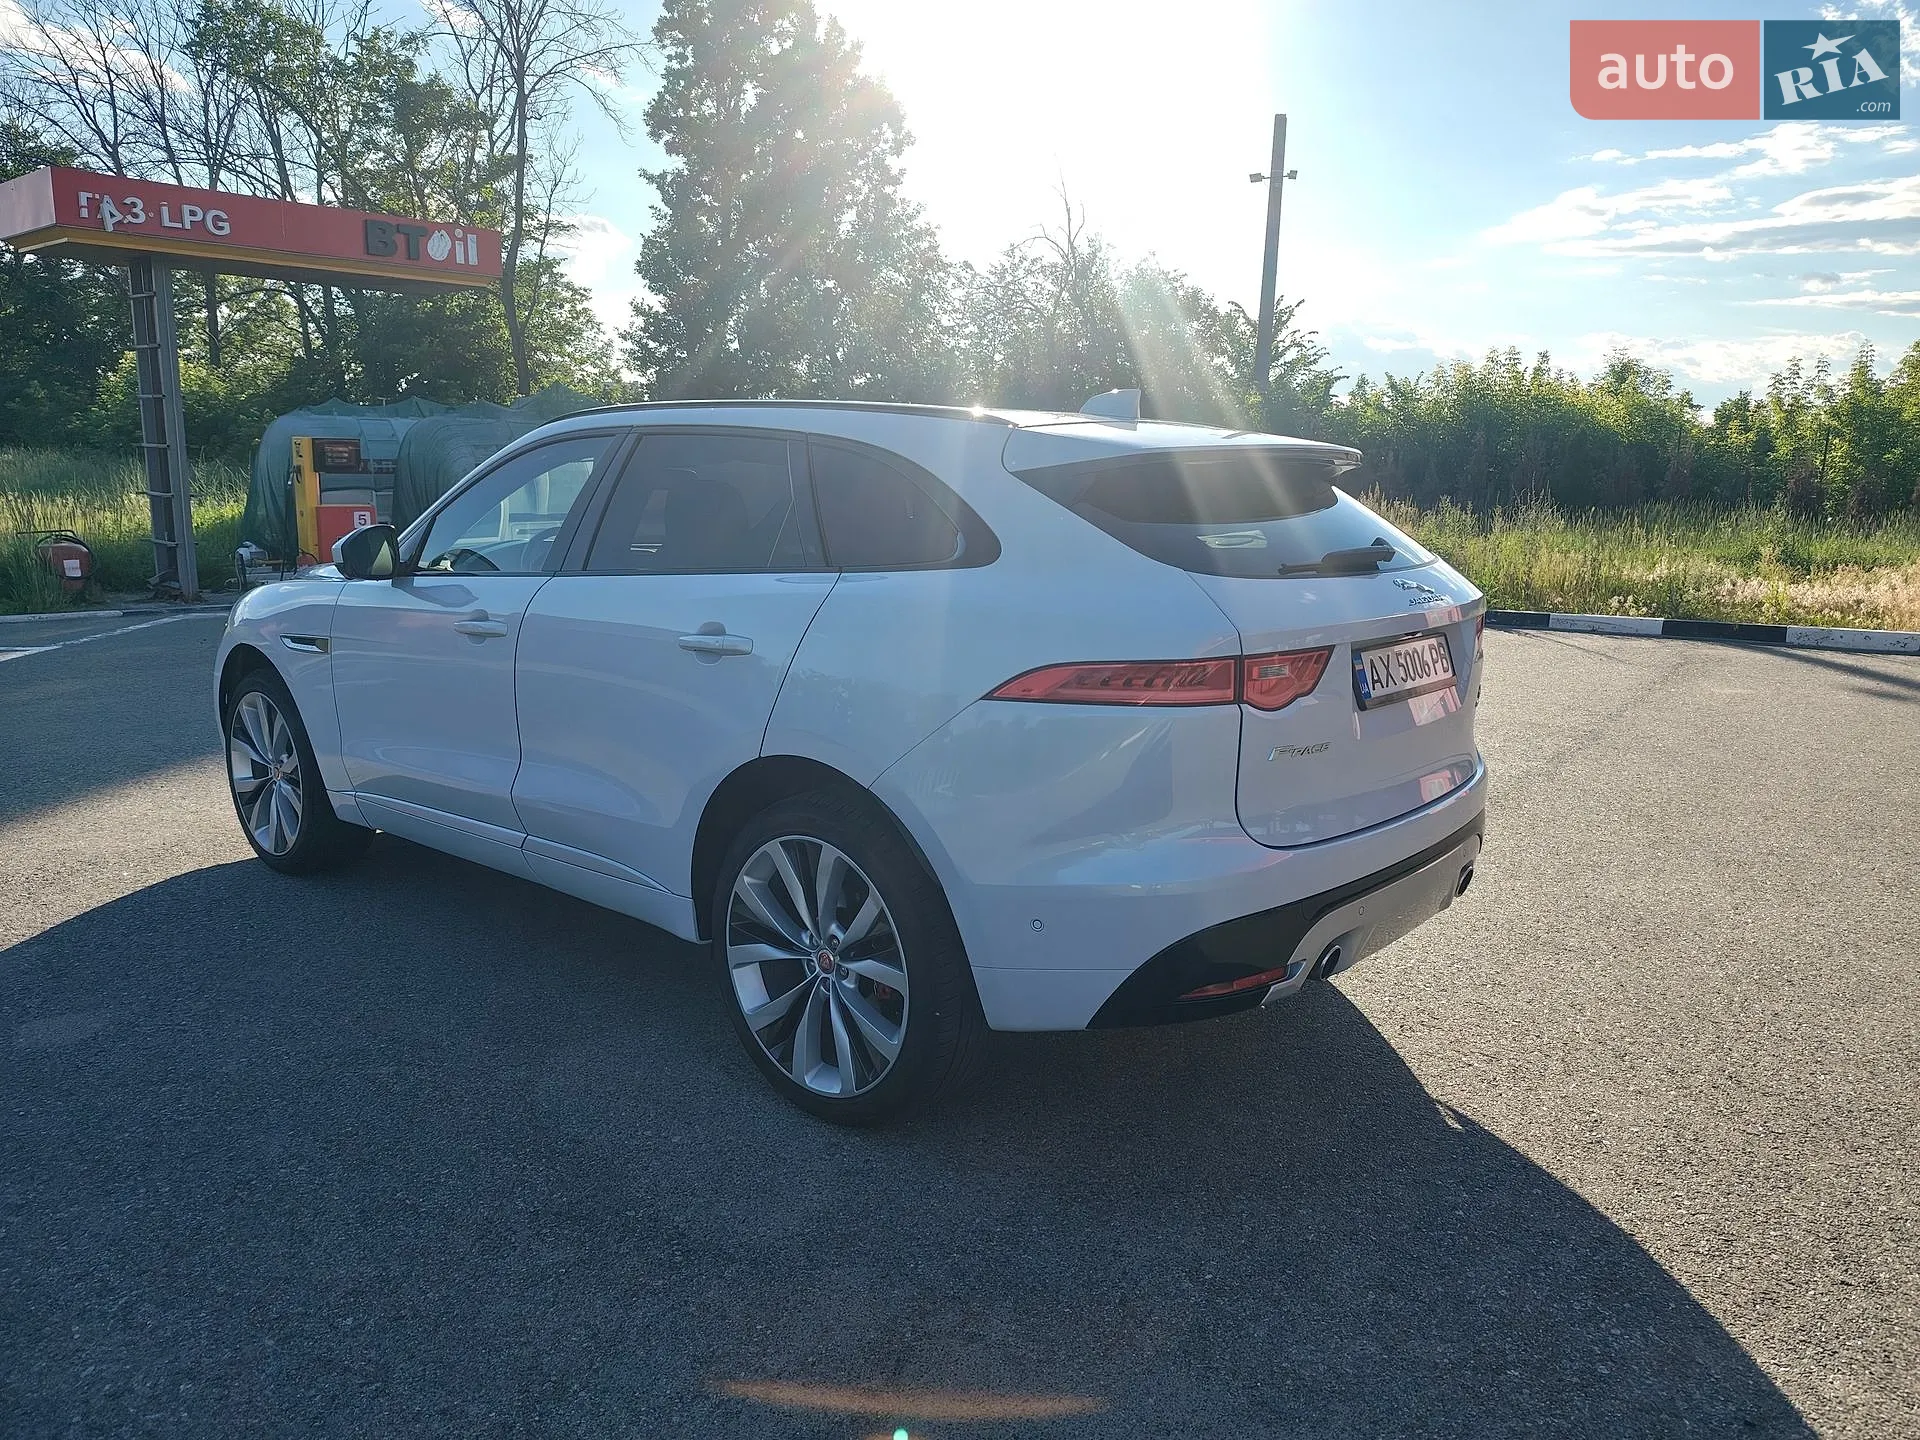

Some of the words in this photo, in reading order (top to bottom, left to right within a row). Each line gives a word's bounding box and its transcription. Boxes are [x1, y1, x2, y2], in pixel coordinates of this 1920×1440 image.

[160, 201, 231, 236] LPG
[358, 513, 367, 526] 5
[1409, 593, 1447, 607] JAGUA
[1369, 653, 1397, 691] AX
[1395, 643, 1431, 683] 5006
[1428, 640, 1450, 676] PB
